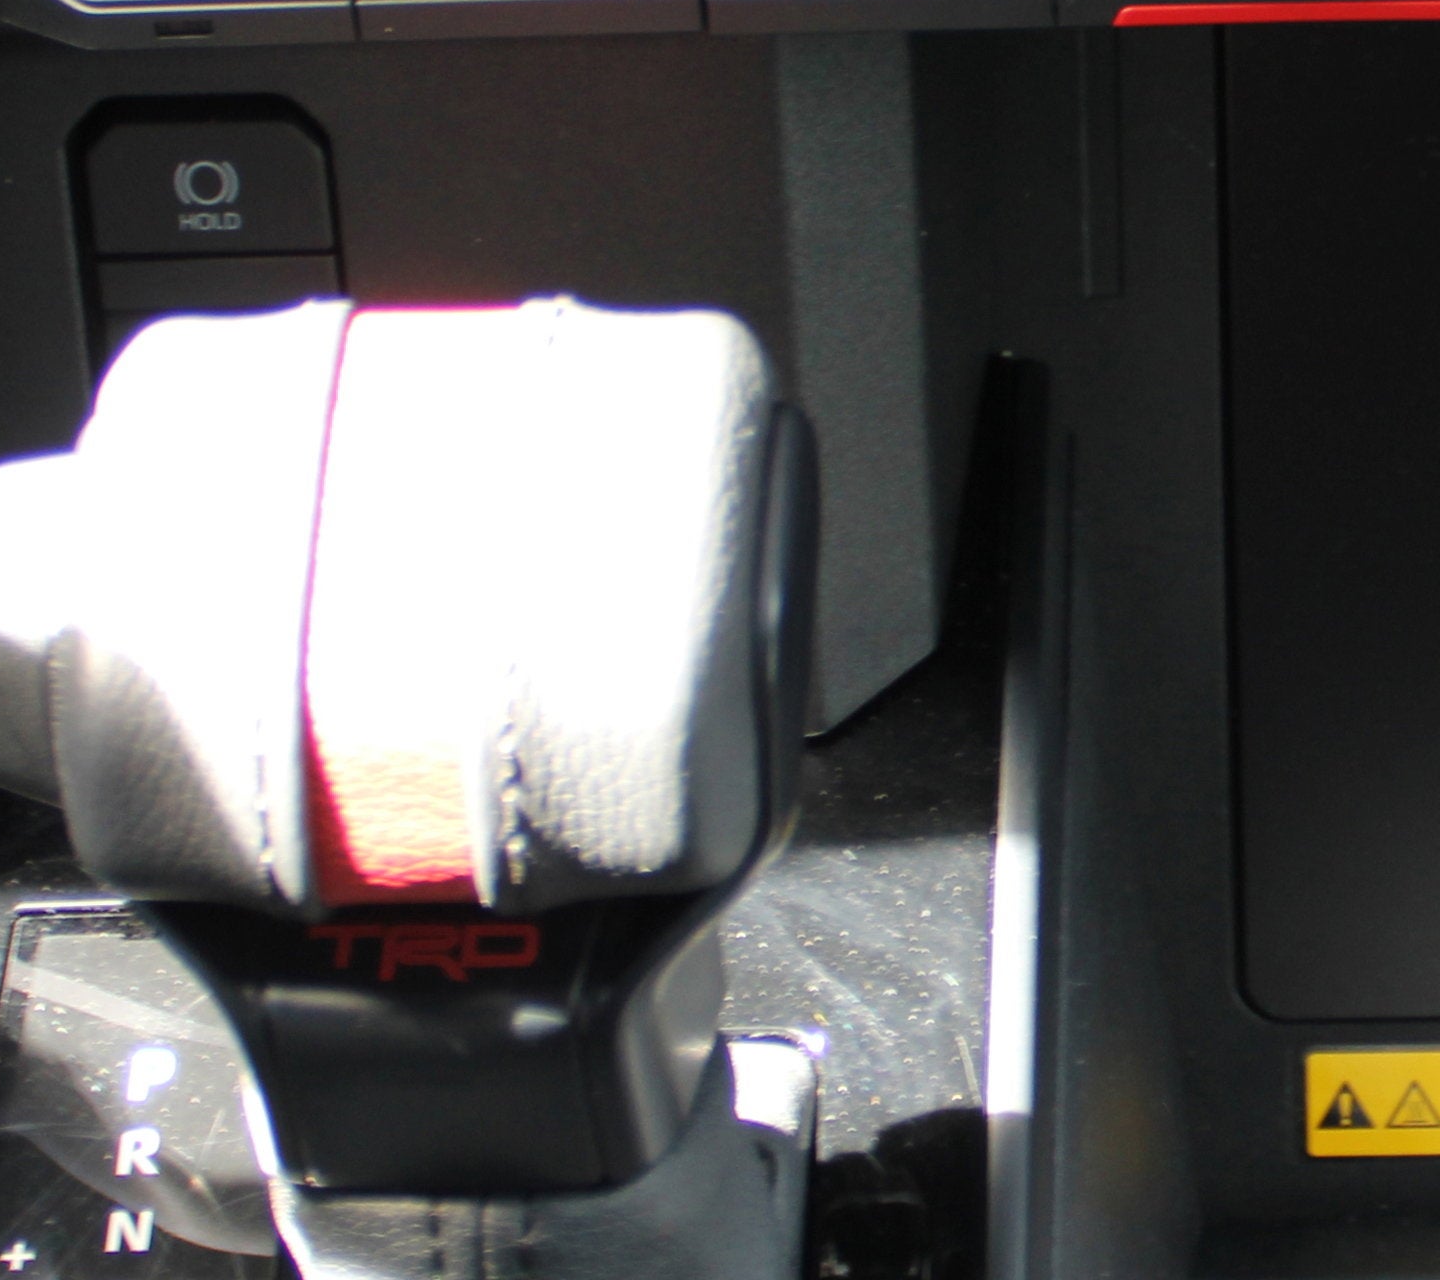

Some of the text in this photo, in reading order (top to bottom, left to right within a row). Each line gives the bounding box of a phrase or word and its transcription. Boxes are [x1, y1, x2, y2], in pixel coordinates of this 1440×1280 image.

[180, 212, 241, 231] HOLD
[309, 924, 539, 981] TRD
[126, 1047, 177, 1102] P
[116, 1128, 162, 1177] R
[103, 1210, 154, 1253] N
